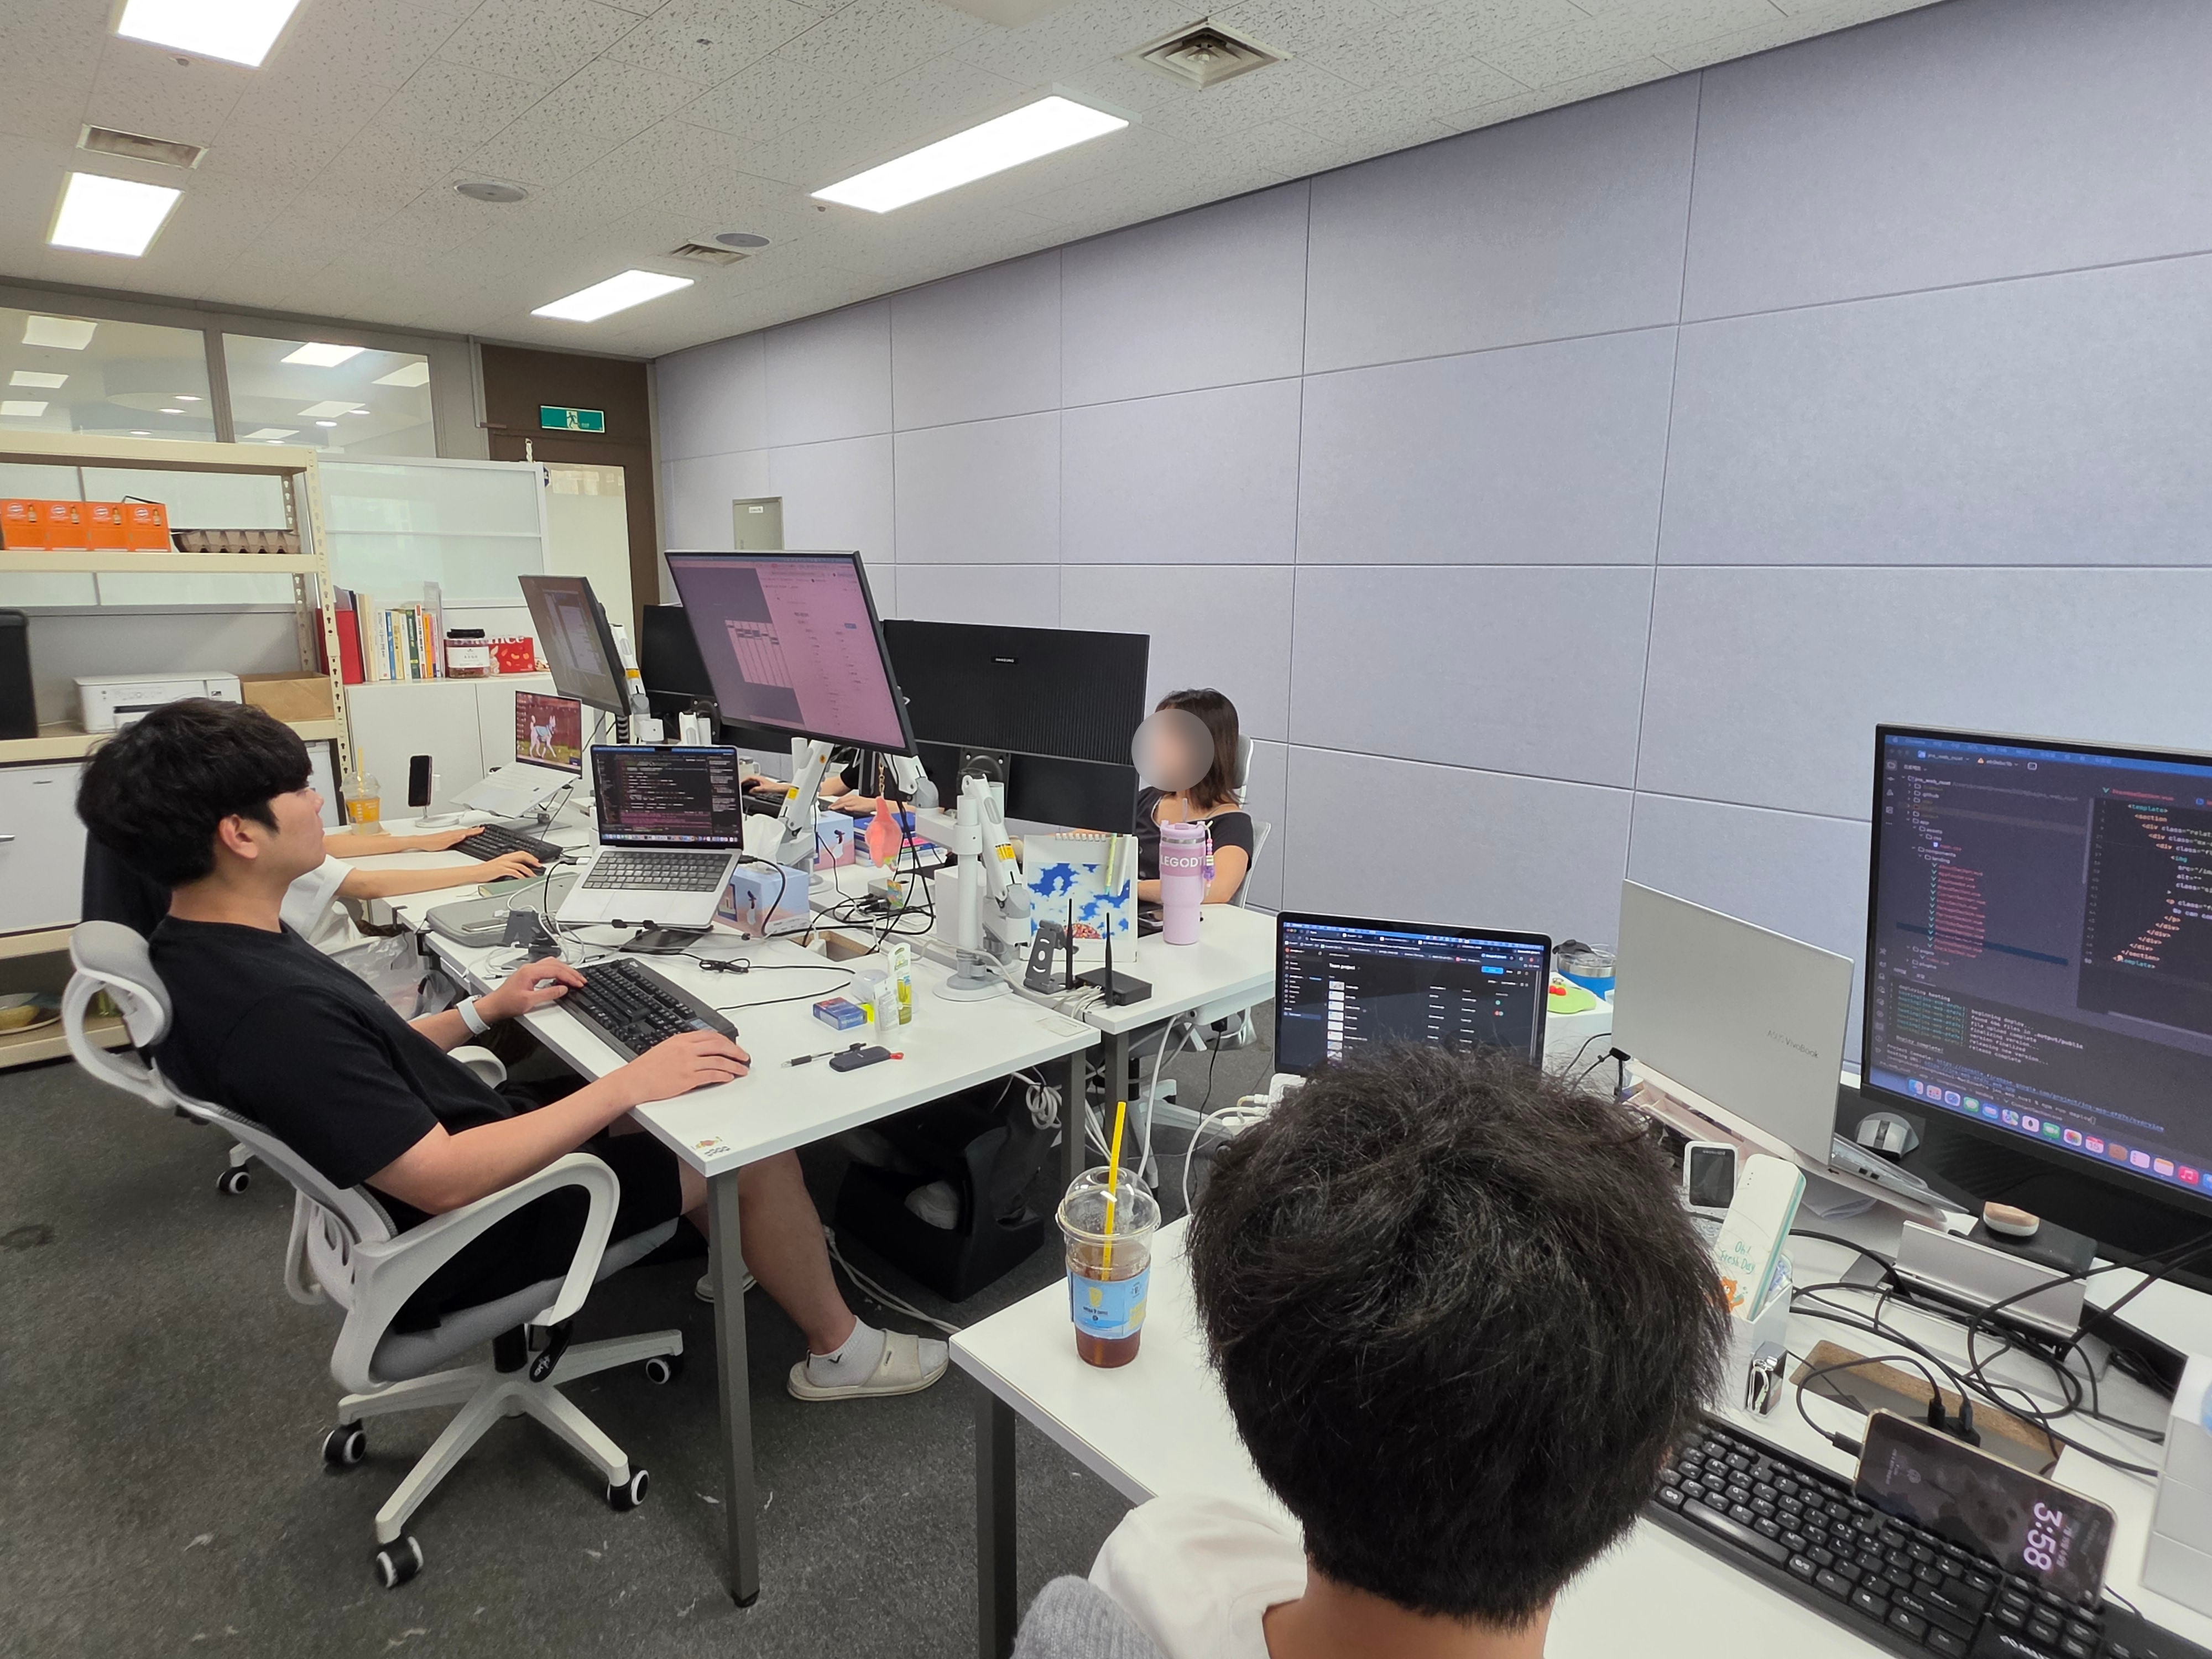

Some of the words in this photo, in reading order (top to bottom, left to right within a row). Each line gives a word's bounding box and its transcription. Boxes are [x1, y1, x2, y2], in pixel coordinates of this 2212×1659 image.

[1785, 1037, 1819, 1058] VivoBook
[1735, 1241, 1752, 1256] Oh!
[1720, 1250, 1739, 1267] Fresh
[1741, 1258, 1756, 1275] Day
[2023, 1501, 2063, 1572] 3:58
